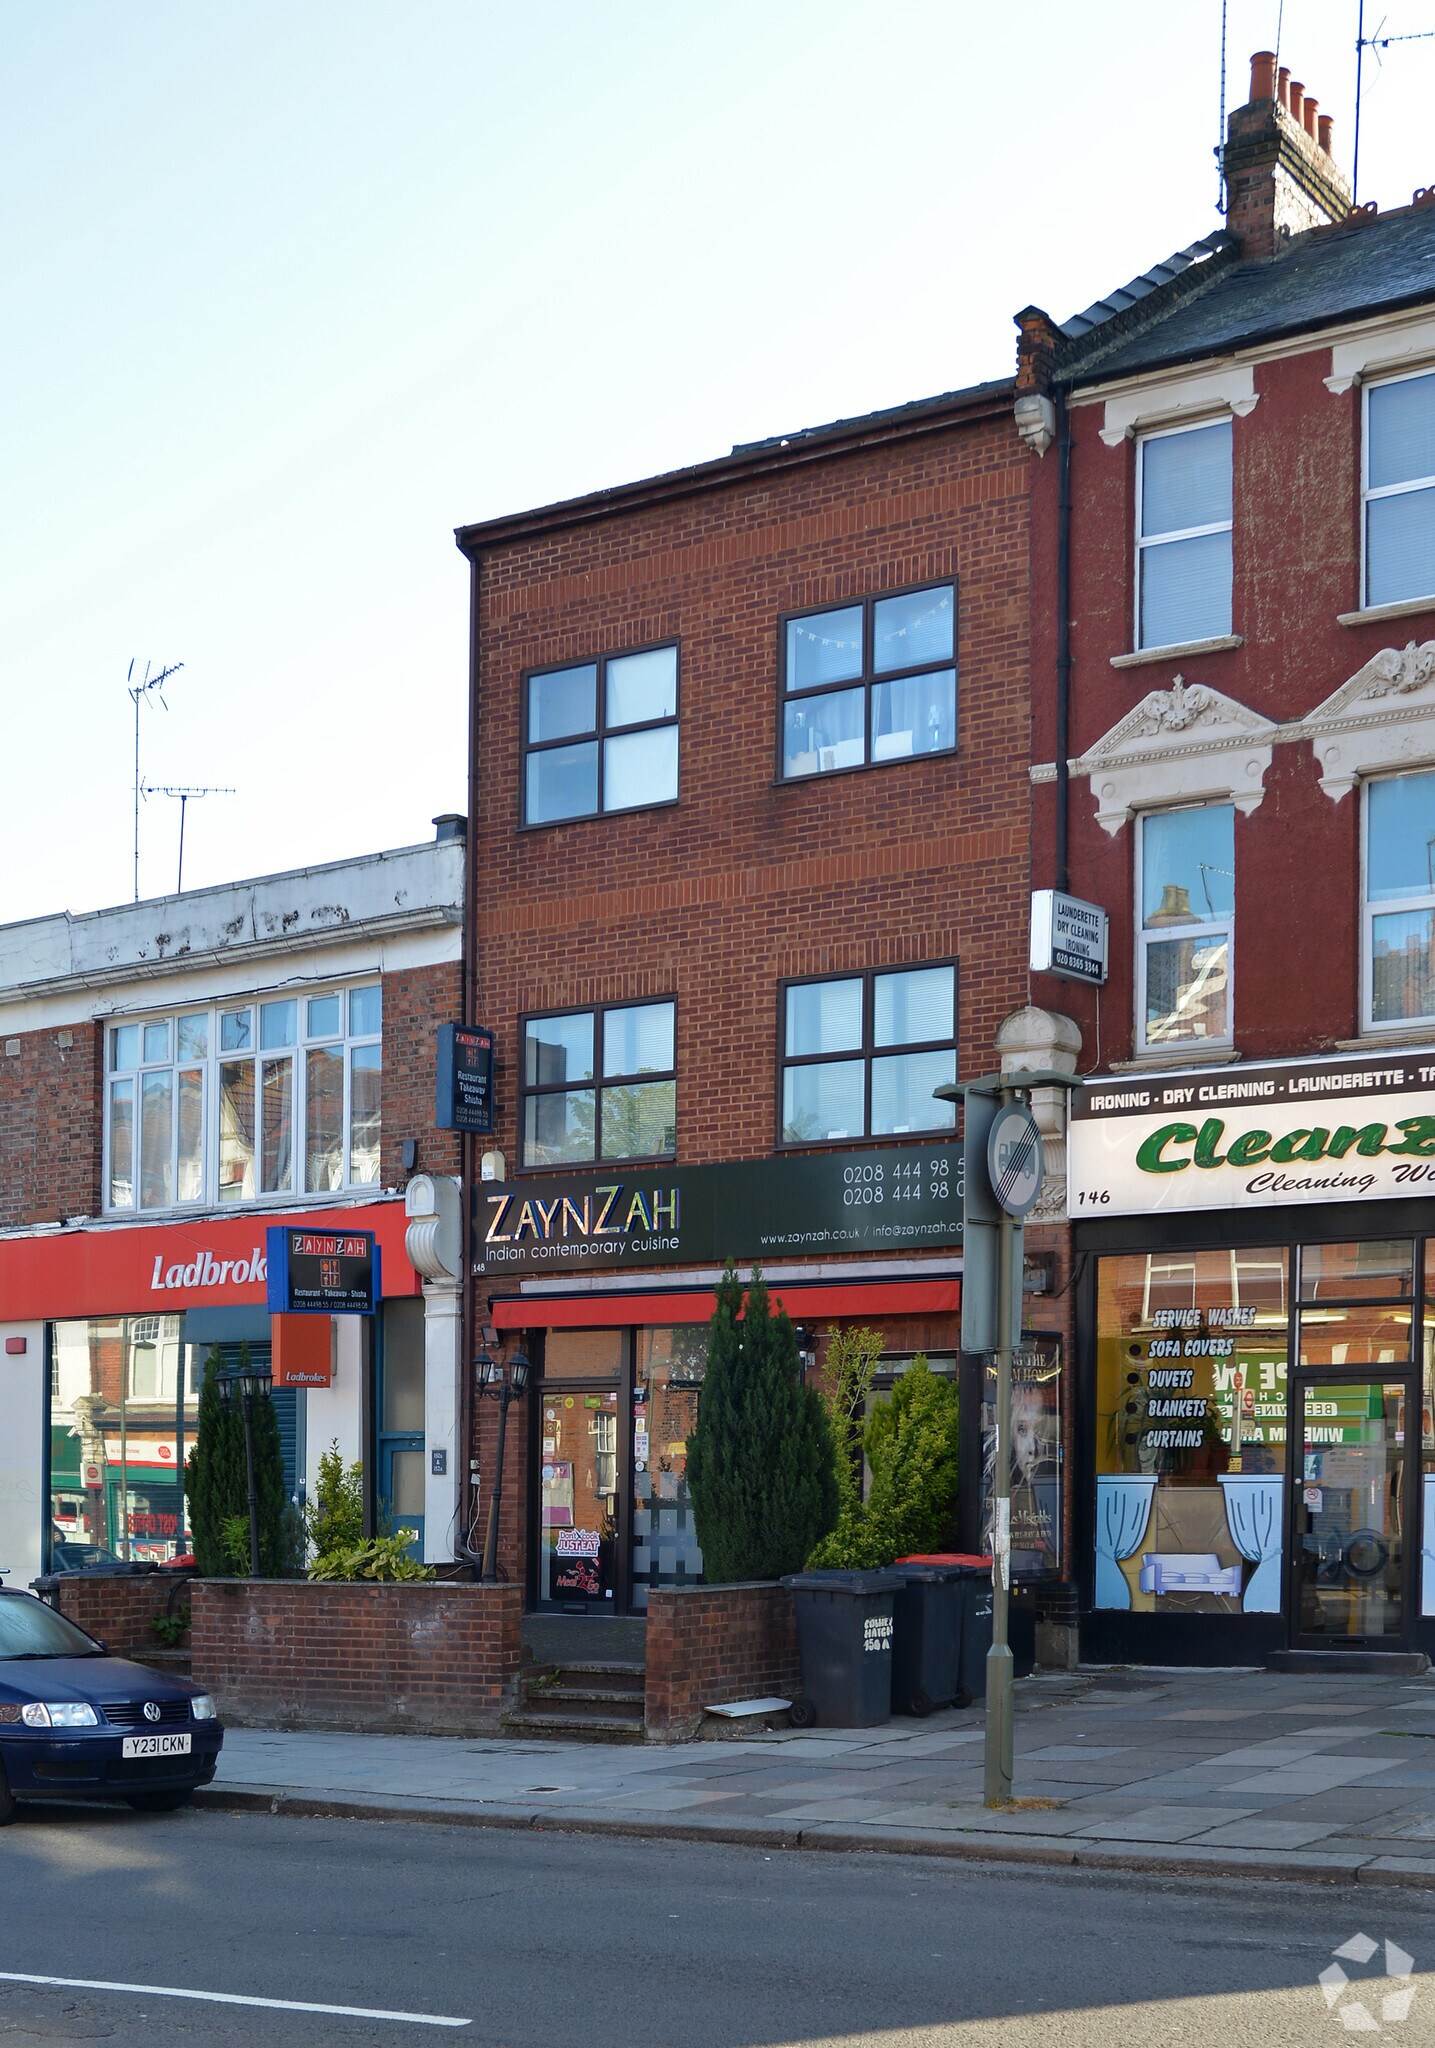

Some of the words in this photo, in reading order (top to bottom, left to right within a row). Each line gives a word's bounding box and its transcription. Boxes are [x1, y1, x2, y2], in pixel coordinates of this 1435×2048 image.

[1057, 902, 1099, 928] LAUNDERETTE
[1057, 920, 1069, 934] DRY
[1070, 924, 1099, 944] CLEANING
[1065, 938, 1090, 957] IRONING
[1056, 951, 1068, 965] 020
[1084, 960, 1099, 974] 3344
[457, 1070, 487, 1085] Restaurant
[459, 1082, 486, 1095] Takeaway
[1090, 1092, 1150, 1111] IRONING
[1163, 1087, 1194, 1105] DRY
[1199, 1081, 1275, 1102] CLEANING
[1288, 1069, 1404, 1094] LAUNDERETTE
[464, 1094, 483, 1106] Shisha
[843, 1164, 884, 1184] 0208
[892, 1161, 921, 1179] 444
[930, 1158, 950, 1177] 98
[1245, 1171, 1379, 1195] Cleaning
[843, 1186, 884, 1206] 0208
[892, 1183, 921, 1201] 444
[930, 1182, 950, 1199] 98
[1078, 1190, 1111, 1206] 146
[485, 1184, 680, 1243] ZAYNZAH
[760, 1227, 860, 1245] www.zaynzah.co.uk
[293, 1236, 365, 1256] ZAYNZAH
[485, 1246, 526, 1261] Indian
[530, 1240, 626, 1258] contemporary
[631, 1236, 680, 1252] cuisine
[151, 1247, 267, 1290] Ladbrok
[473, 1263, 486, 1273] 148
[294, 1288, 321, 1297] Restaurant
[324, 1289, 347, 1298] Takeaway
[351, 1290, 367, 1298] Shisha
[293, 1300, 306, 1308] 0208
[333, 1301, 346, 1309] 0208
[1152, 1308, 1201, 1328] SERVICE
[1207, 1306, 1256, 1326] WASHES
[1148, 1338, 1181, 1358] SOFA
[1184, 1338, 1234, 1357] COVERS
[285, 1371, 327, 1382] Ladbrokes
[1148, 1370, 1193, 1388] DUVETS
[1148, 1399, 1207, 1417] BLANKETS
[1146, 1430, 1203, 1448] CURTAINS
[559, 1540, 579, 1550] JUST
[581, 1540, 598, 1551] EAT
[132, 1737, 160, 1754] Y231
[162, 1736, 185, 1752] CKN
